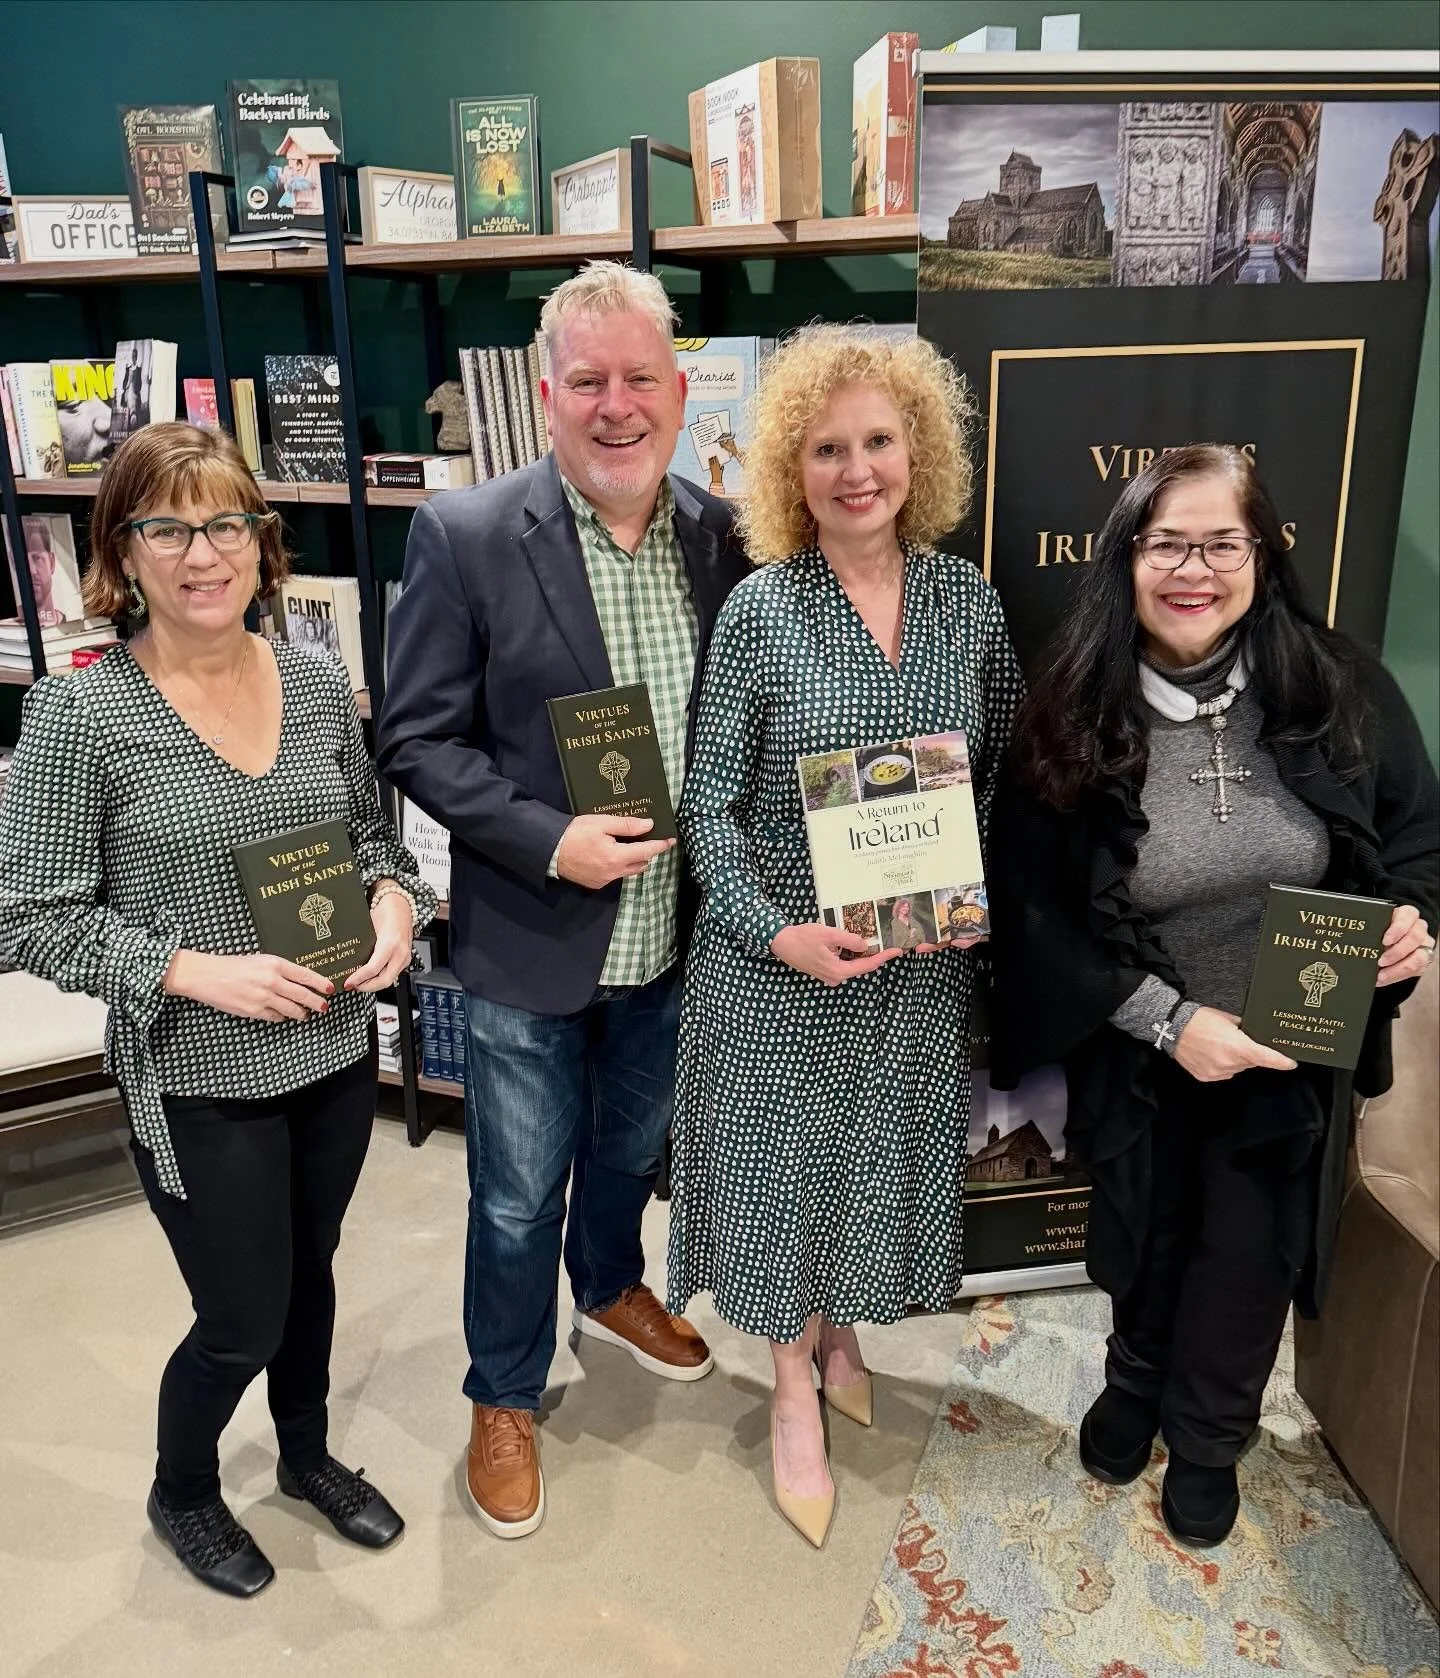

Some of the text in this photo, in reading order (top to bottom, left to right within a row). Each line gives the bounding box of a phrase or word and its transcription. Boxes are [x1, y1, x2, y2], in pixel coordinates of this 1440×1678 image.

[238, 92, 310, 108] Celebrating
[240, 107, 330, 123] Backyard Birds
[479, 115, 512, 129] ALL
[466, 126, 526, 143] IS NOW
[476, 140, 520, 154] LOST
[66, 201, 120, 221] Dad's
[483, 216, 518, 224] LAURA
[472, 223, 529, 234] ELIZABETH
[275, 394, 340, 404] BEST MIND
[281, 451, 322, 459] JONATHAN
[288, 596, 331, 619] CLINT
[576, 704, 630, 722] VIRTUES
[566, 725, 650, 750] IRISH SAINTS
[594, 803, 621, 813] LESSONS
[630, 807, 647, 815] LOVE
[857, 802, 925, 820] A Return to
[415, 822, 438, 835] How
[849, 808, 944, 850] Ireland
[408, 836, 433, 850] Walk
[268, 841, 330, 868] VIRTUES
[422, 853, 450, 867] Room
[259, 861, 354, 900] IRISH SAINTS
[1299, 910, 1366, 931] VIRTUES
[296, 949, 326, 964] LESSONS
[337, 937, 360, 950] FAITH,
[1274, 933, 1380, 959] IRISH SAINTS
[306, 958, 328, 968] PEACE
[337, 948, 356, 960] LOVE
[1273, 1010, 1307, 1020] LESSONS
[1319, 1017, 1346, 1028] FAITH,
[1280, 1020, 1304, 1030] PEACE
[1314, 1026, 1336, 1035] LOVE
[1048, 1202, 1066, 1212] For
